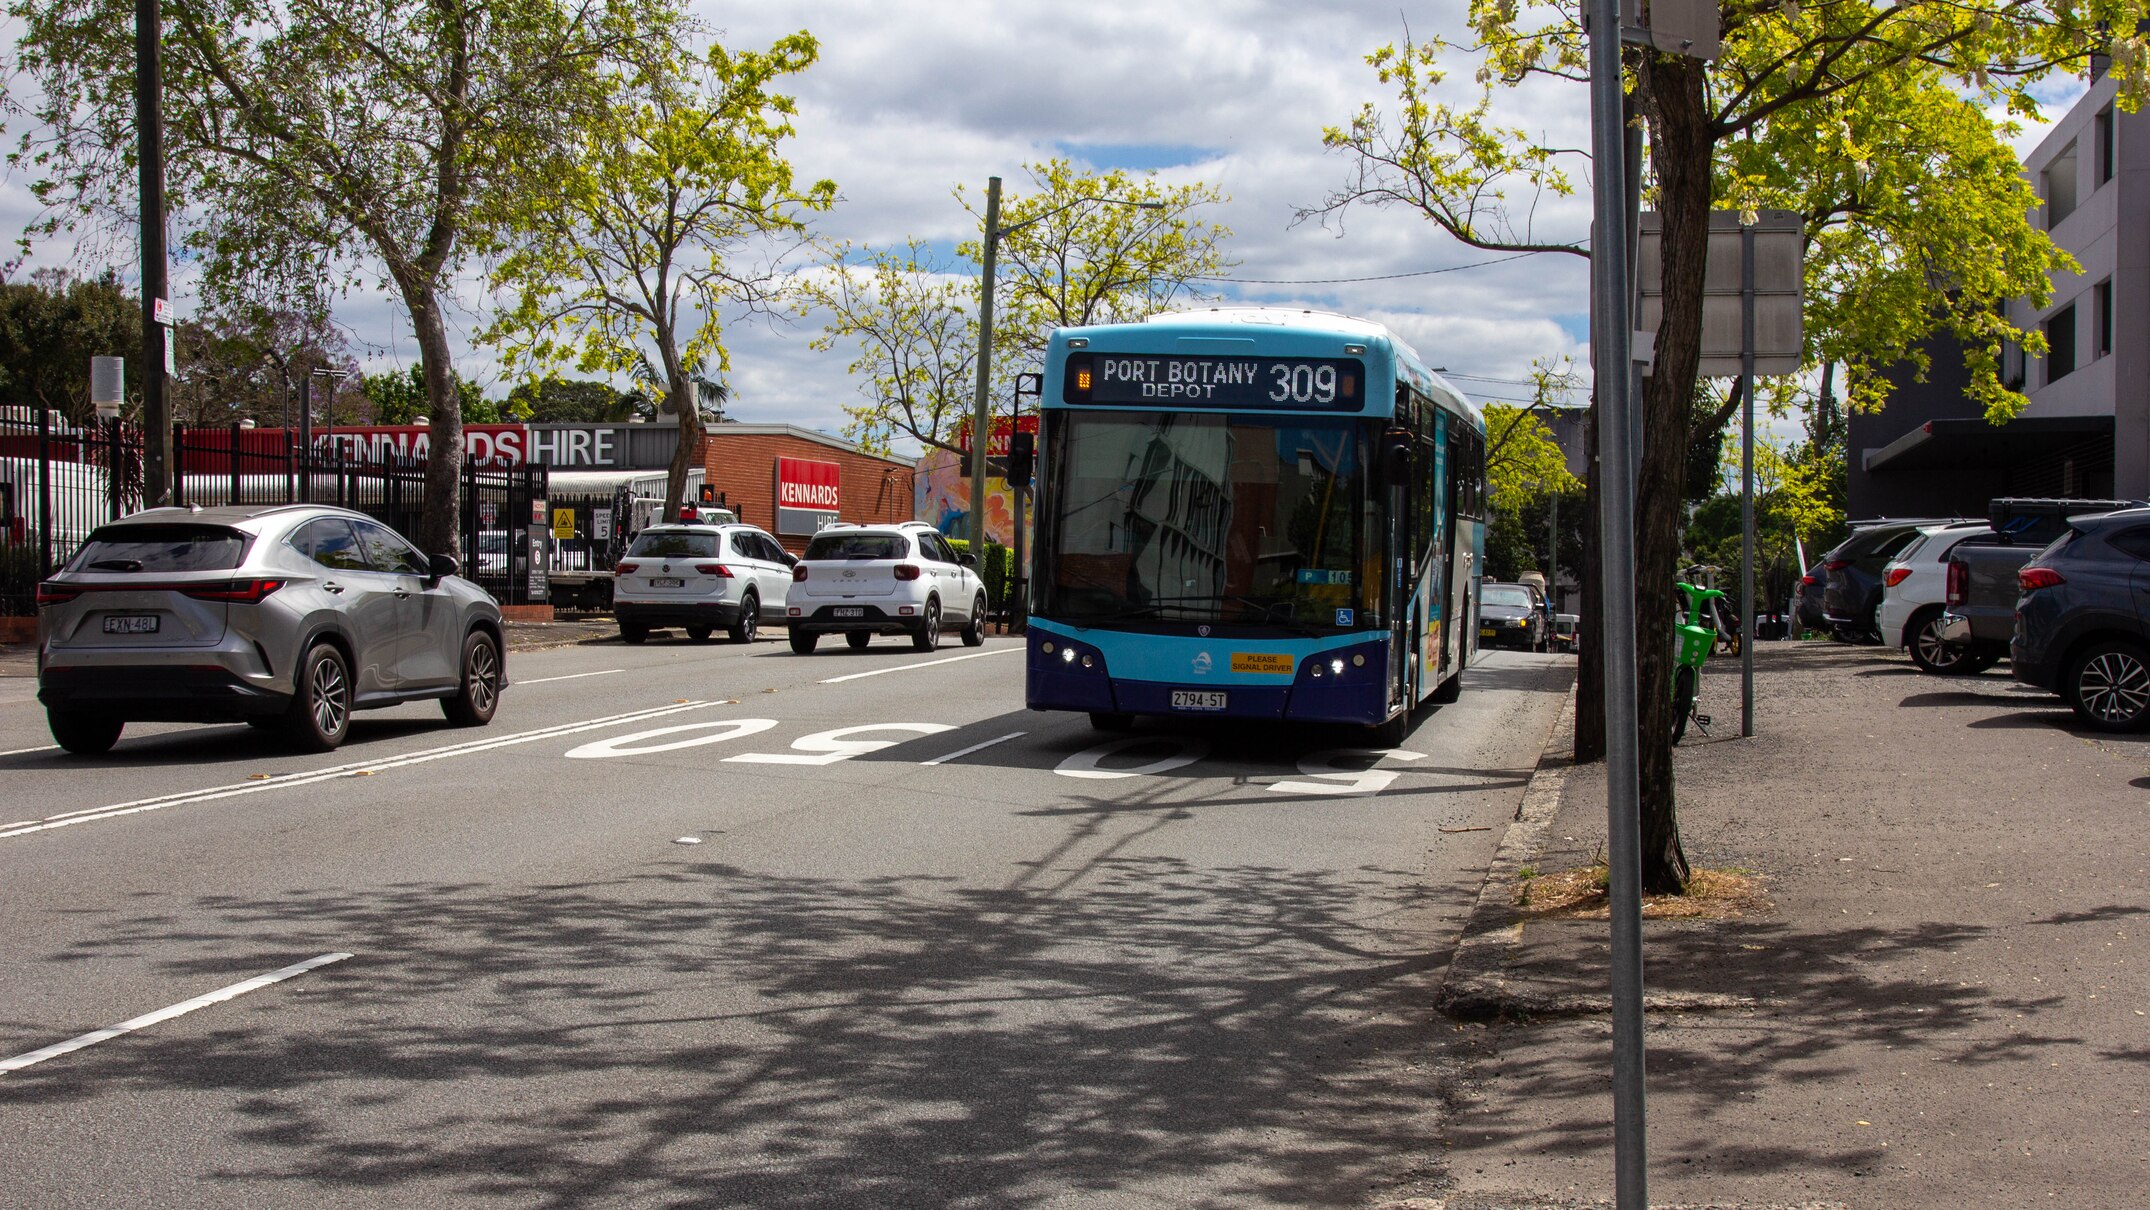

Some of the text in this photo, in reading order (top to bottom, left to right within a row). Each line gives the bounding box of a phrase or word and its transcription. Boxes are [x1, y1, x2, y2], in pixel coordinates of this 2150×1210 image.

[1104, 360, 1258, 384] PORT BOTANY
[1269, 363, 1337, 402] 309
[1142, 383, 1216, 398] DEPOT
[533, 429, 615, 466] HIRE
[781, 482, 838, 505] KENNARDS
[601, 526, 608, 537] 5
[532, 538, 542, 549] Entry
[1247, 655, 1277, 663] PLEASE
[1232, 663, 1292, 672] SIGNAL DRIVER
[1174, 692, 1224, 707] 2794-ST
